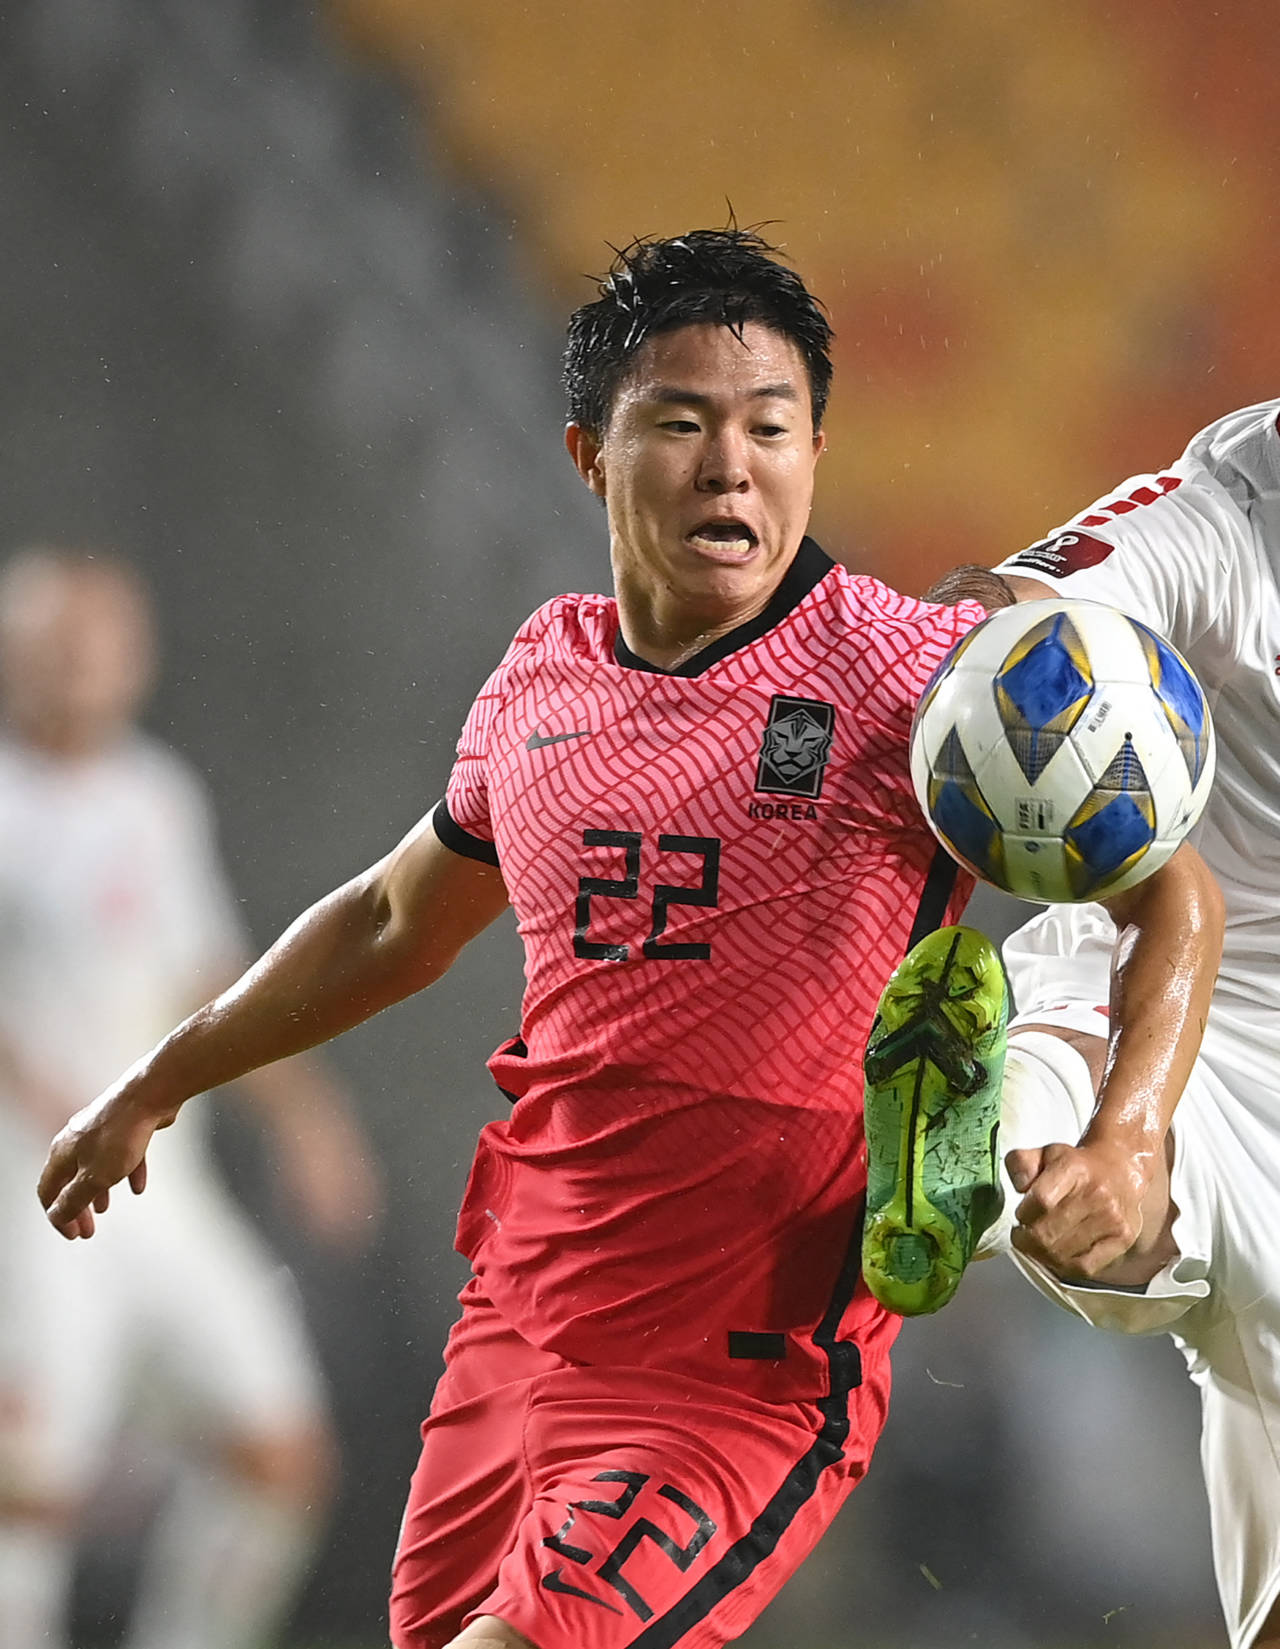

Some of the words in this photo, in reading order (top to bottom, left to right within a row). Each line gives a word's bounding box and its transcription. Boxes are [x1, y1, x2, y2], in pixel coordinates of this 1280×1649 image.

[748, 802, 818, 820] KOREA
[573, 828, 722, 962] 22
[540, 1469, 718, 1623] 22
